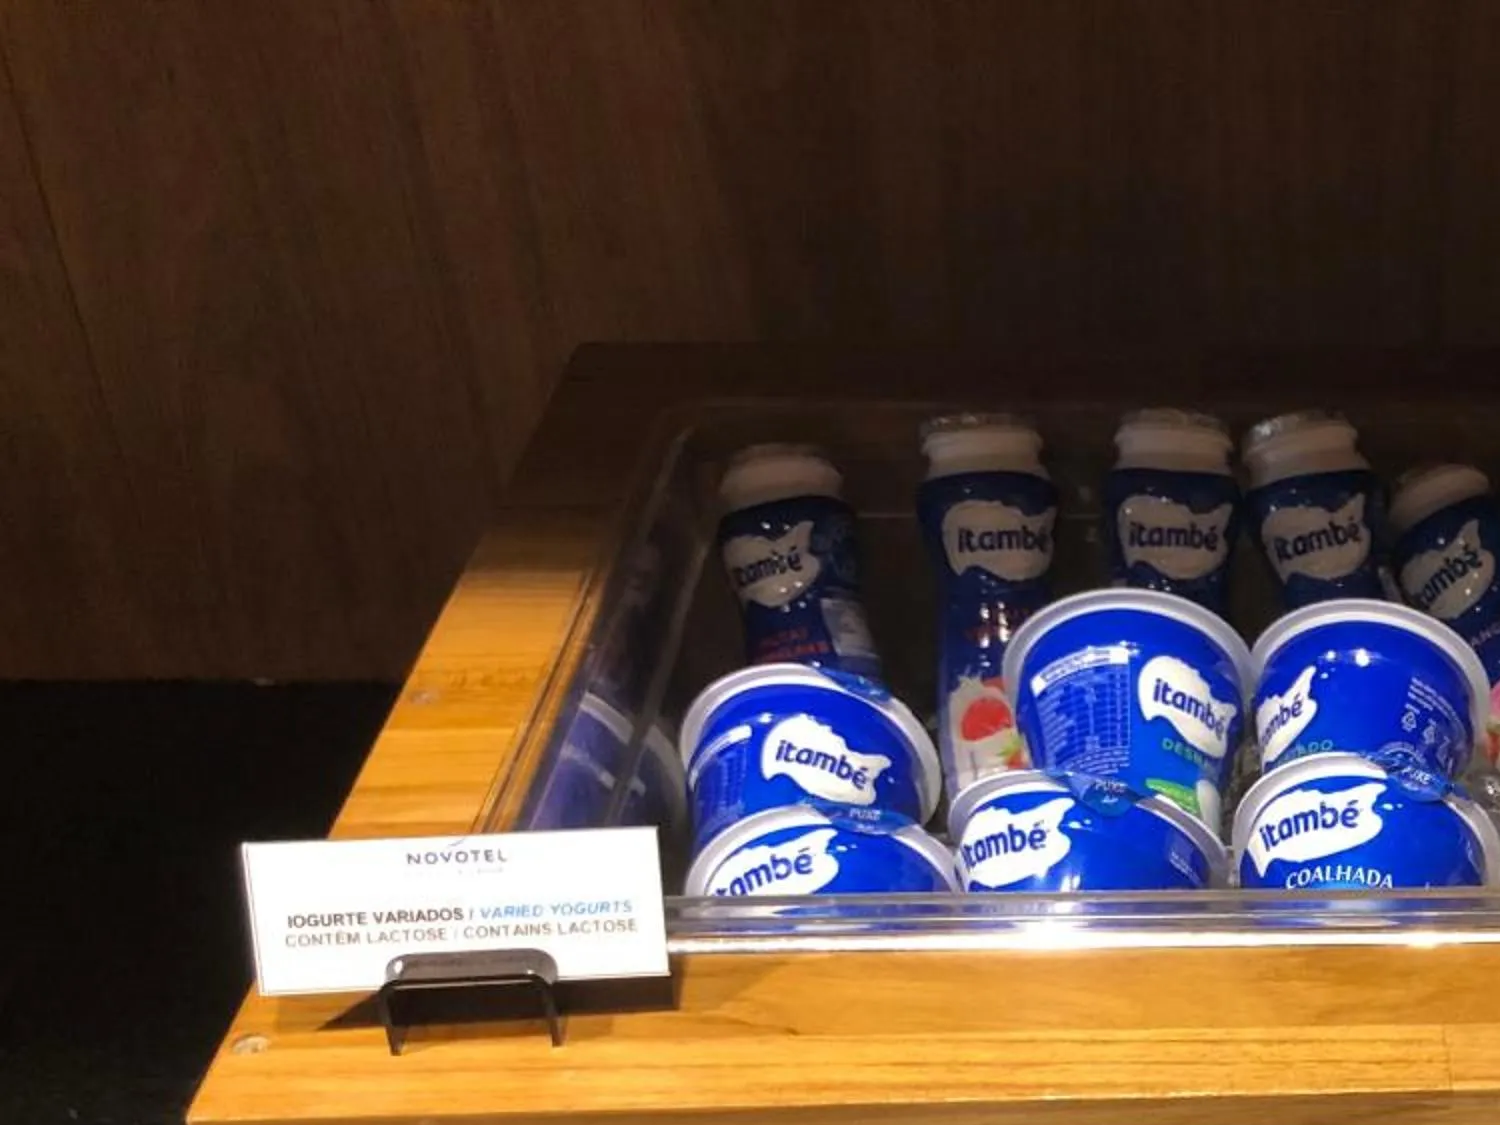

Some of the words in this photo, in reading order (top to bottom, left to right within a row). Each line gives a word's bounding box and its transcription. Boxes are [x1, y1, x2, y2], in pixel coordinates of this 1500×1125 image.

[1127, 514, 1218, 552] itambé
[1274, 514, 1363, 562] itambé
[1153, 677, 1226, 741] itambé
[774, 739, 868, 790] itambé
[1259, 799, 1360, 852] itambé
[406, 848, 508, 866] NOVOTEL
[1285, 864, 1394, 890] COALHADA
[287, 910, 368, 929] IOGURTE
[373, 906, 464, 925] VARIADOS
[480, 903, 544, 920] VARIED
[550, 900, 633, 916] YOGURTS
[366, 926, 449, 945] LACTOSE
[463, 922, 552, 940] CONTAINS
[557, 918, 639, 936] LACTOSE
